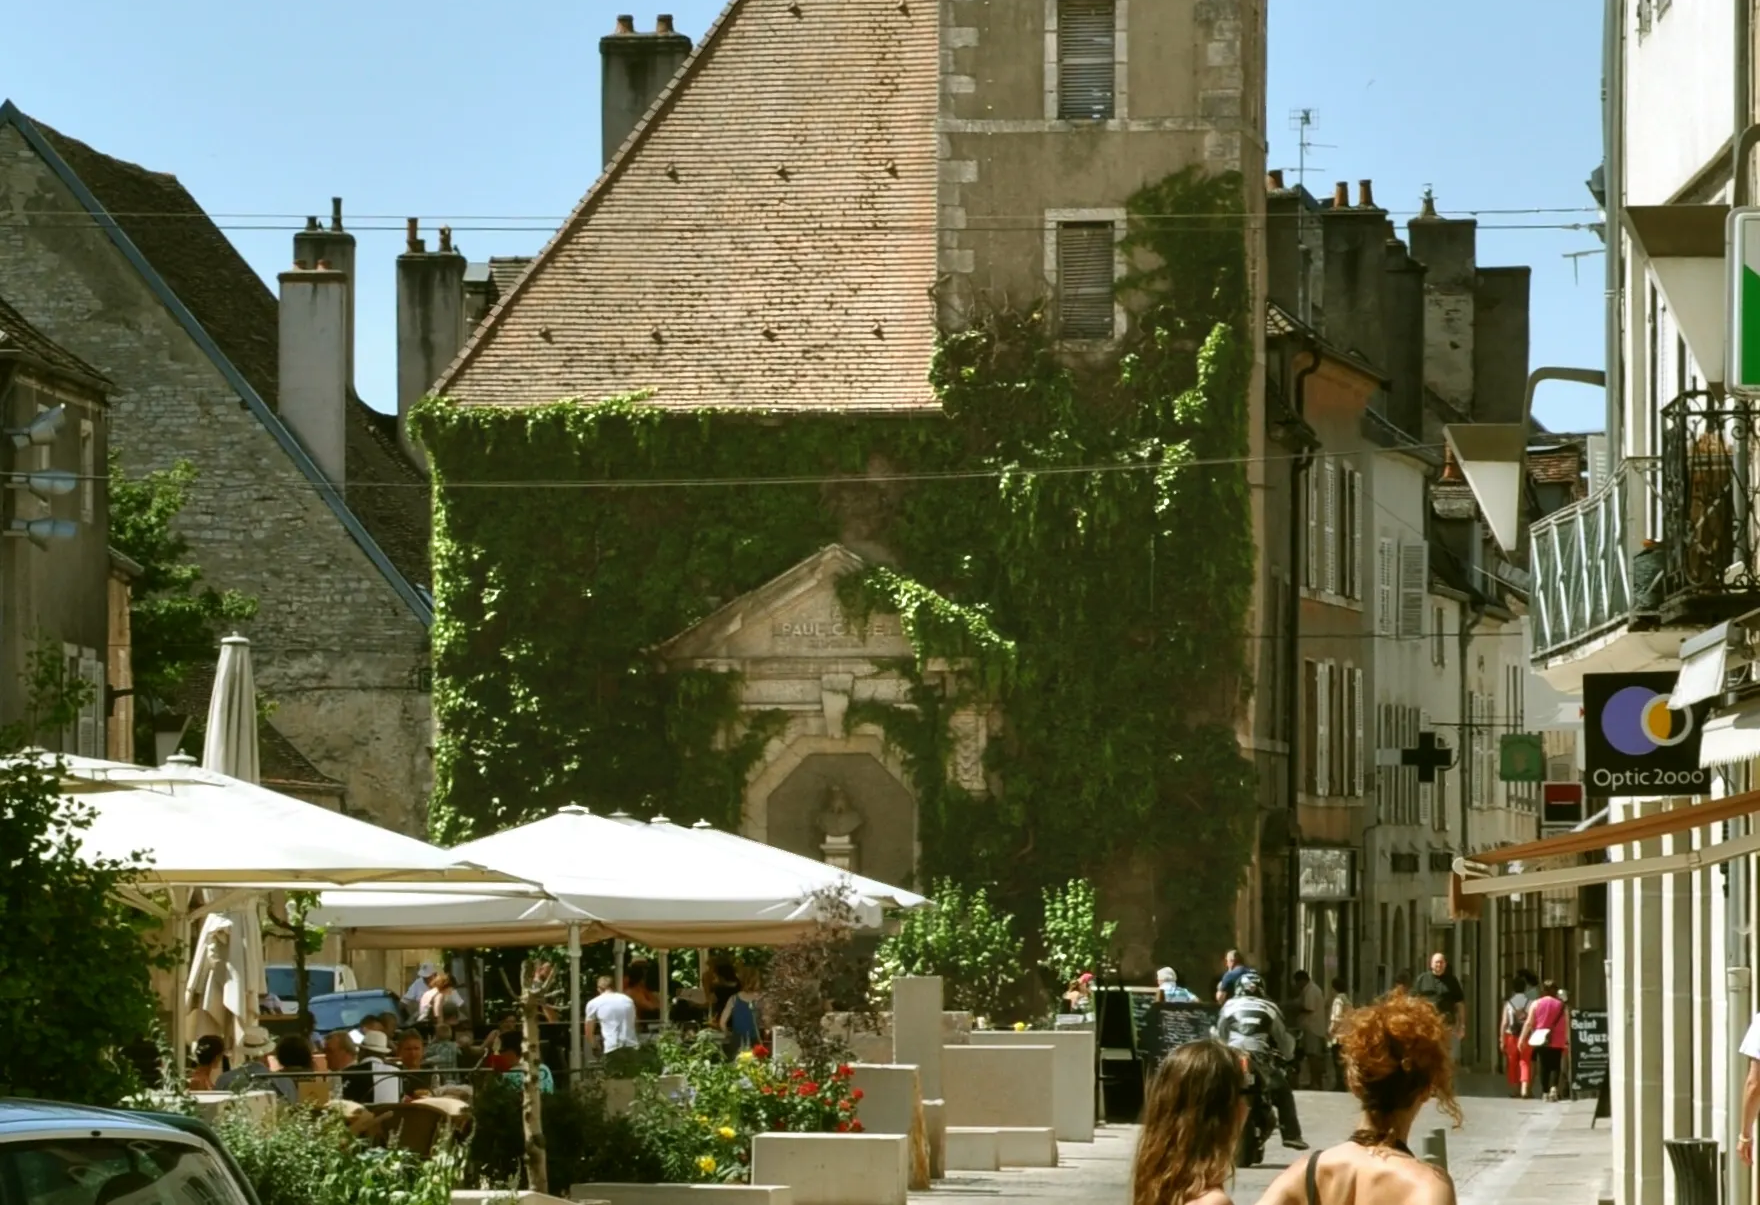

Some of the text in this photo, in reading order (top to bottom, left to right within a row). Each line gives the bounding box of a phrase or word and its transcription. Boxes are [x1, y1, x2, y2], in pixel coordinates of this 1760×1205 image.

[782, 622, 826, 636] PAUL
[1593, 767, 1704, 791] Optic 2000
